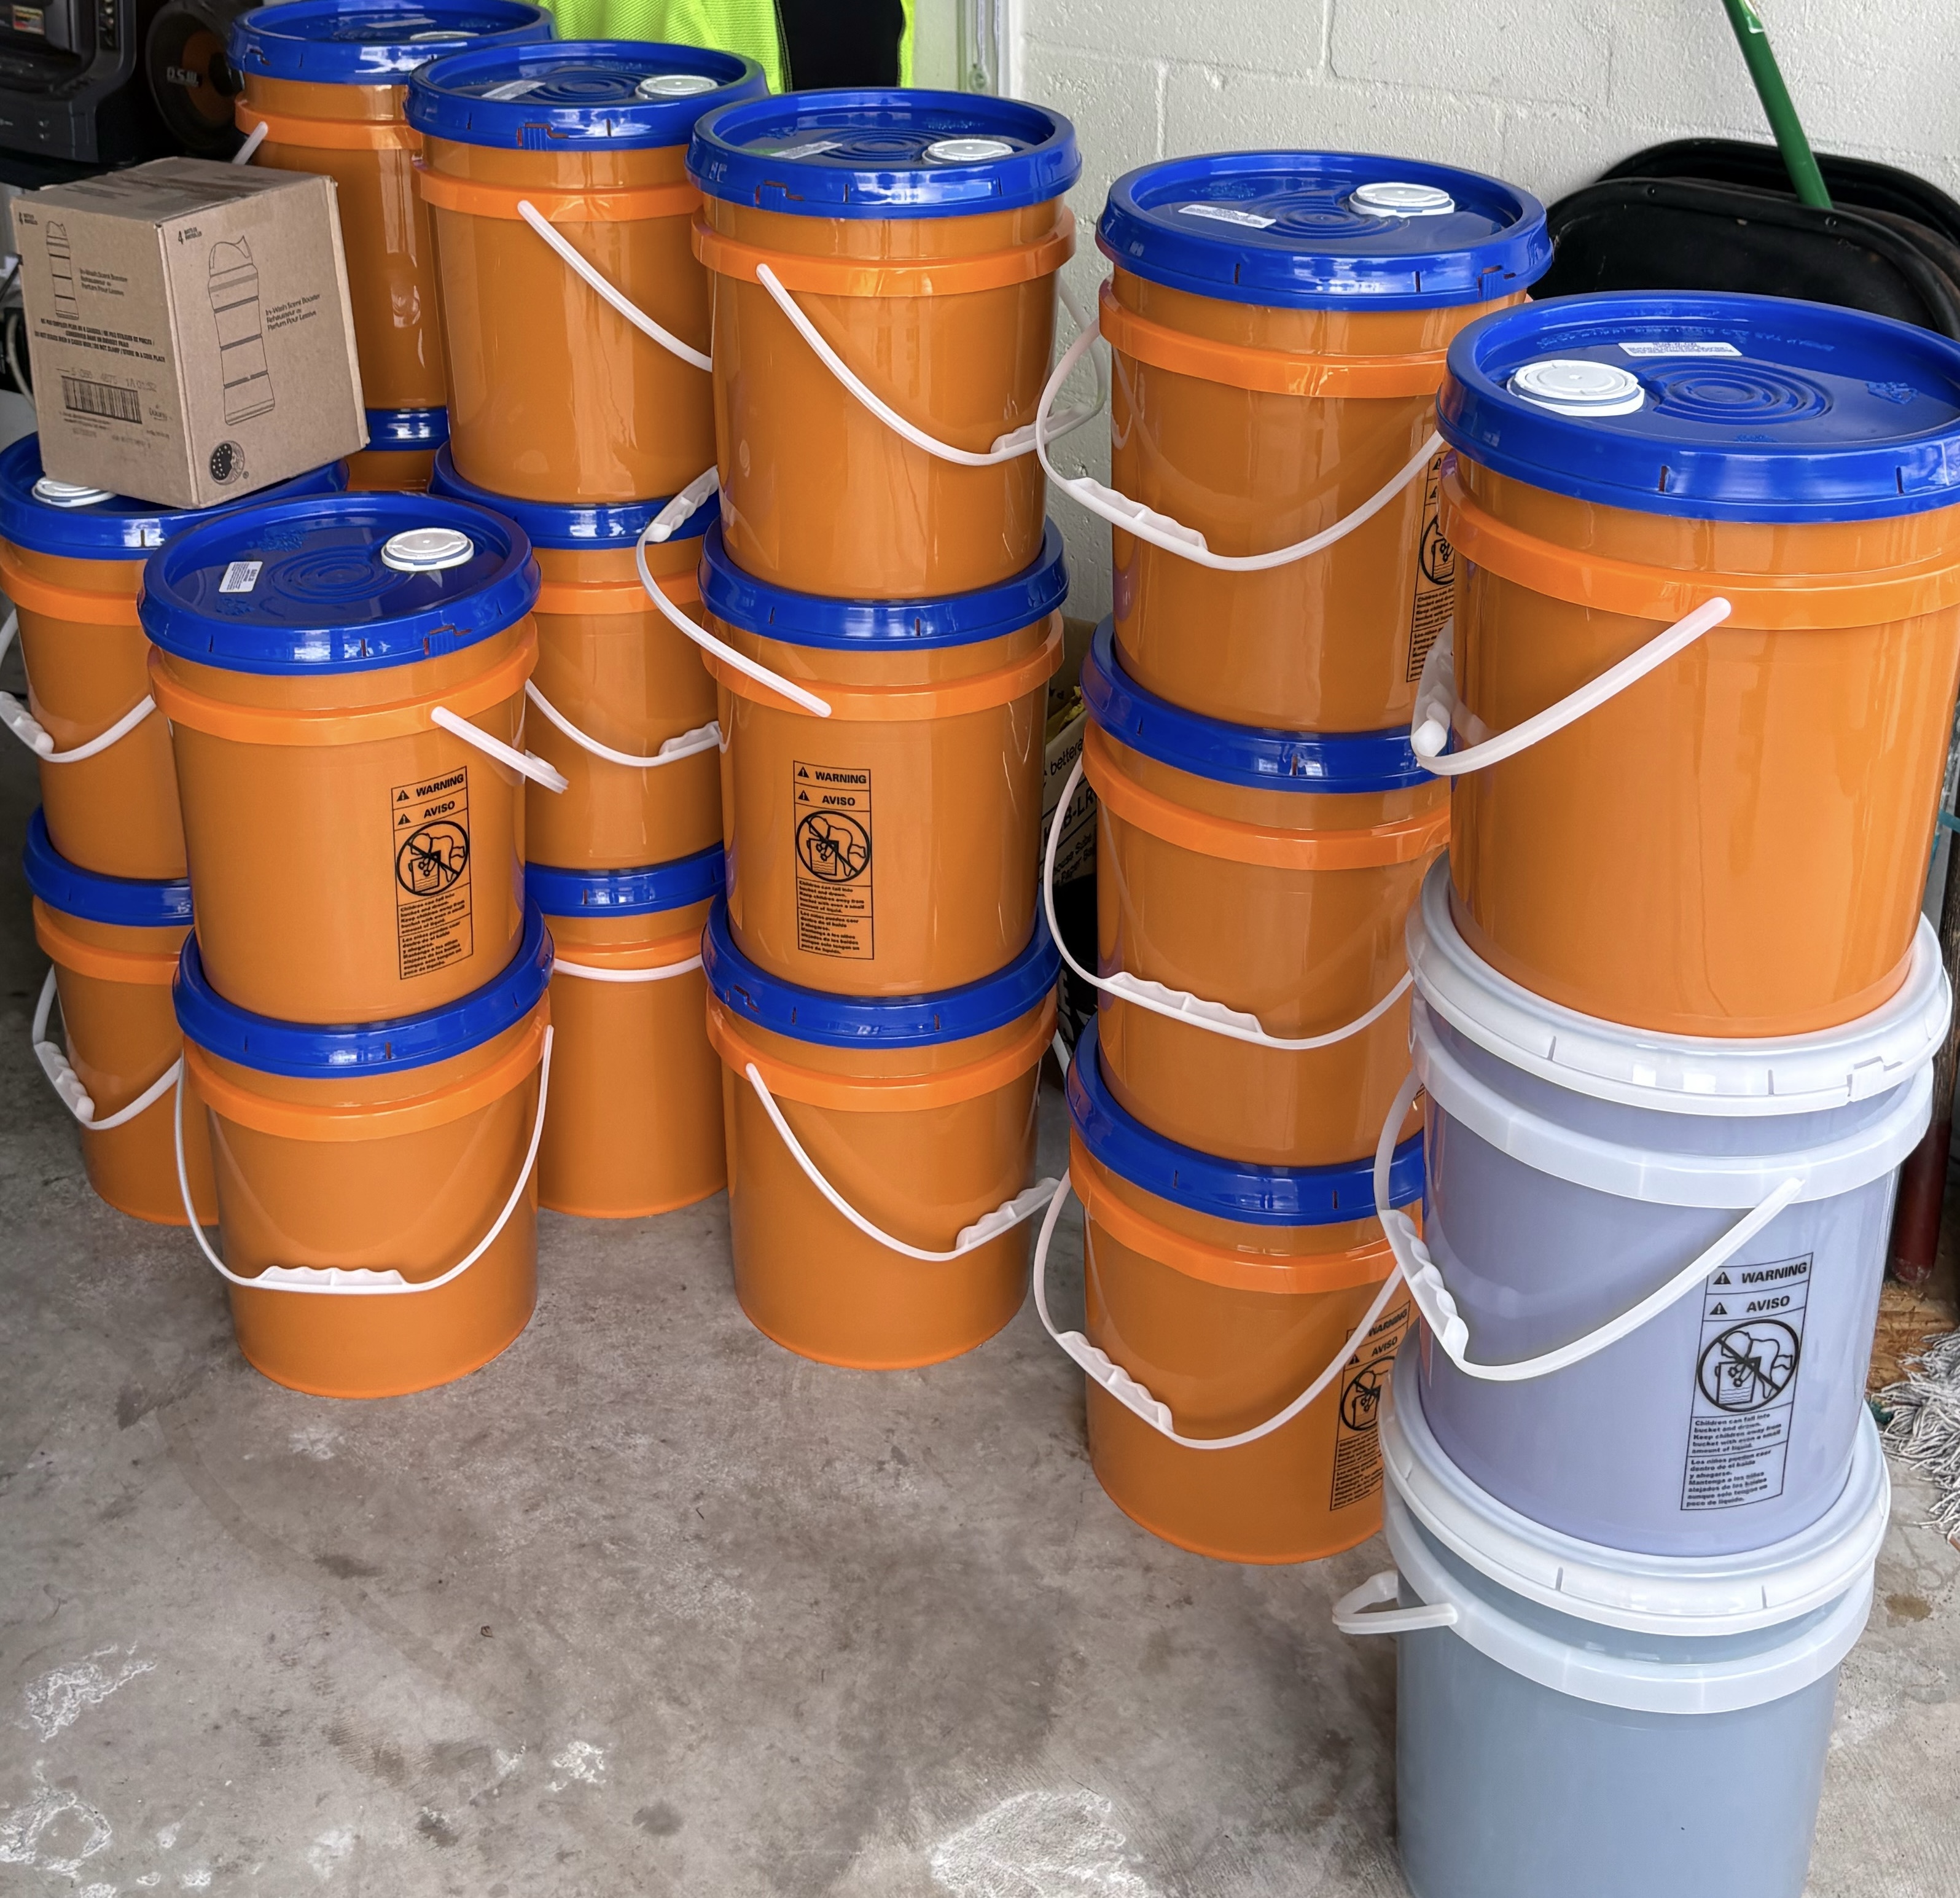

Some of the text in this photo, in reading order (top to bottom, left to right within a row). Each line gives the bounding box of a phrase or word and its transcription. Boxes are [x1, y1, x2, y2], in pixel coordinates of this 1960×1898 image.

[416, 773, 464, 797] WARNING
[816, 771, 867, 784] WARNING
[424, 800, 455, 818] AVISO
[822, 795, 855, 806] AVISO
[1741, 1262, 1807, 1284] WARNING
[1746, 1295, 1790, 1313] AVISO
[1372, 1336, 1397, 1356] AVISO
